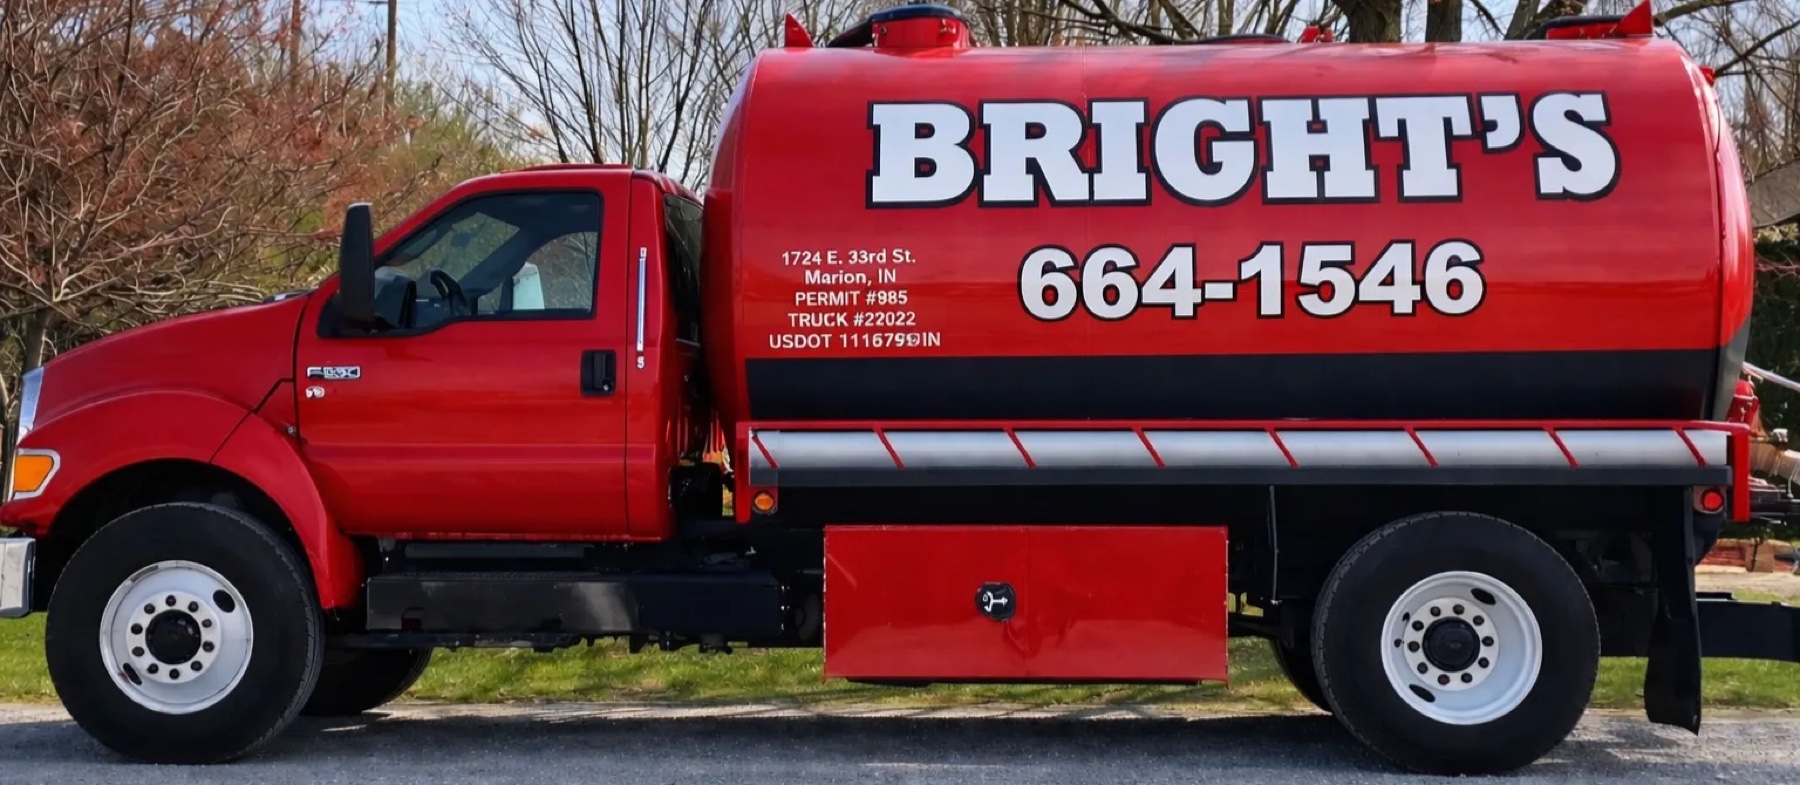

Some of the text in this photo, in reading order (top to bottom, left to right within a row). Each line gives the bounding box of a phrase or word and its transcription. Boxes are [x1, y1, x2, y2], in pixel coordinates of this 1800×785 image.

[866, 93, 1621, 208] BRIGHT'S
[782, 248, 916, 265] 1724 E. 33rd St.
[805, 268, 896, 286] Marion, IN
[1017, 239, 1486, 321] 664-1546
[795, 290, 908, 306] PERMIT #985
[788, 311, 916, 327] TRUCK #22022
[769, 333, 832, 348] USDOT
